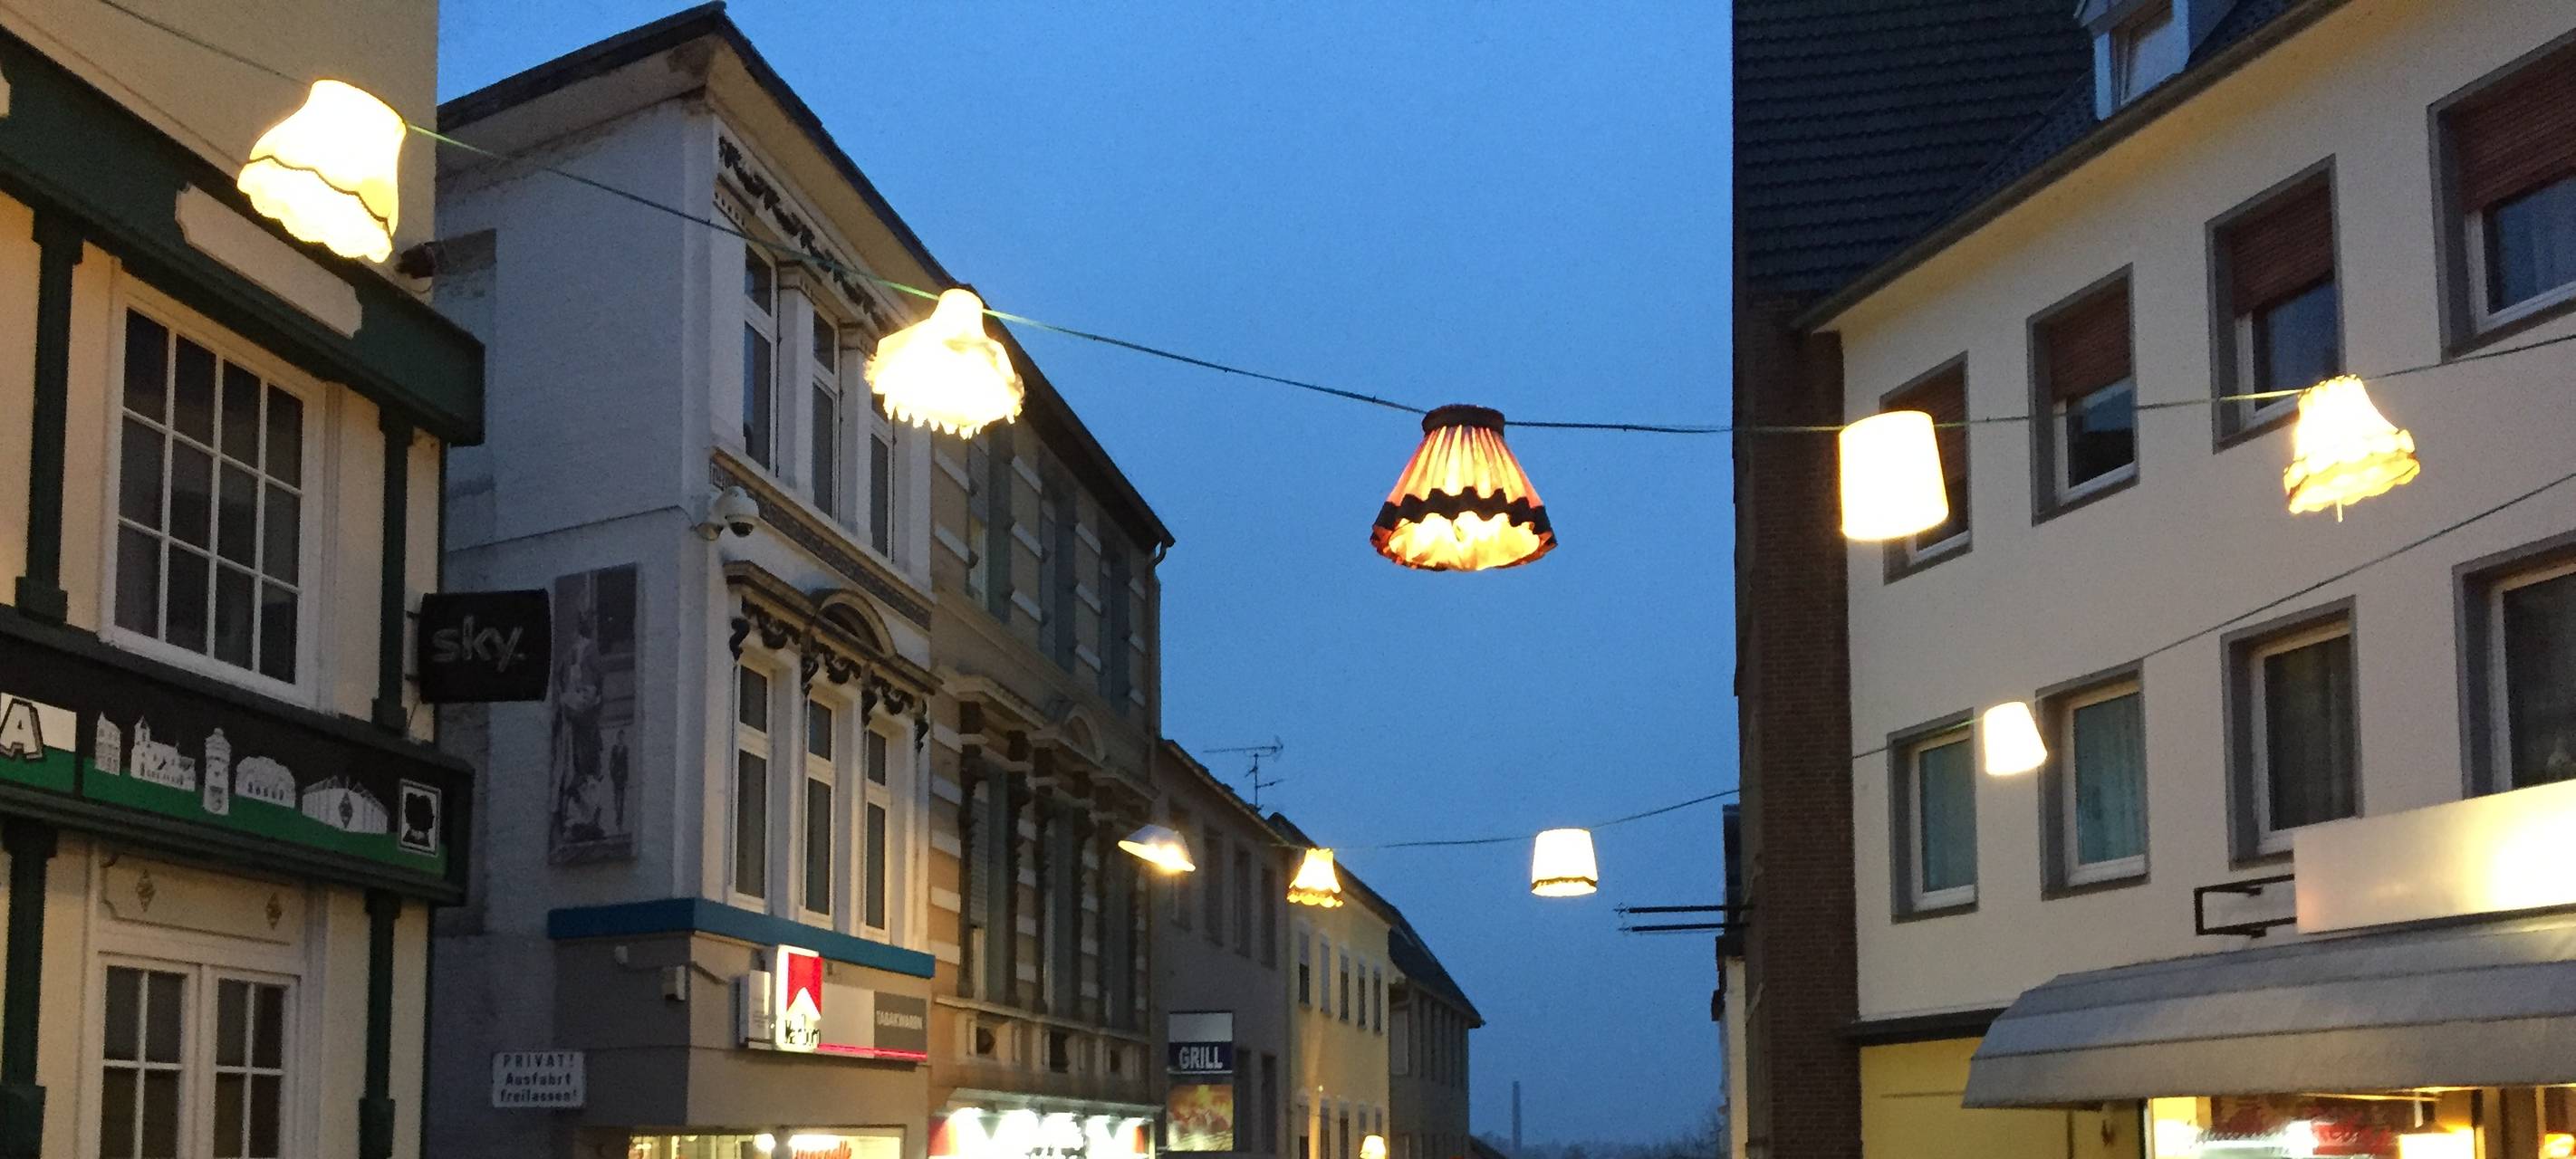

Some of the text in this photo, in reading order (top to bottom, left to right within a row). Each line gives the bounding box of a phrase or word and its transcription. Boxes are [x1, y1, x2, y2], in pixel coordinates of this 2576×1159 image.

[504, 1054, 573, 1068] PRIVAT!
[1179, 1046, 1224, 1069] GRILL
[506, 1072, 571, 1086] Ausfahrt
[500, 1088, 577, 1103] freilassen!
